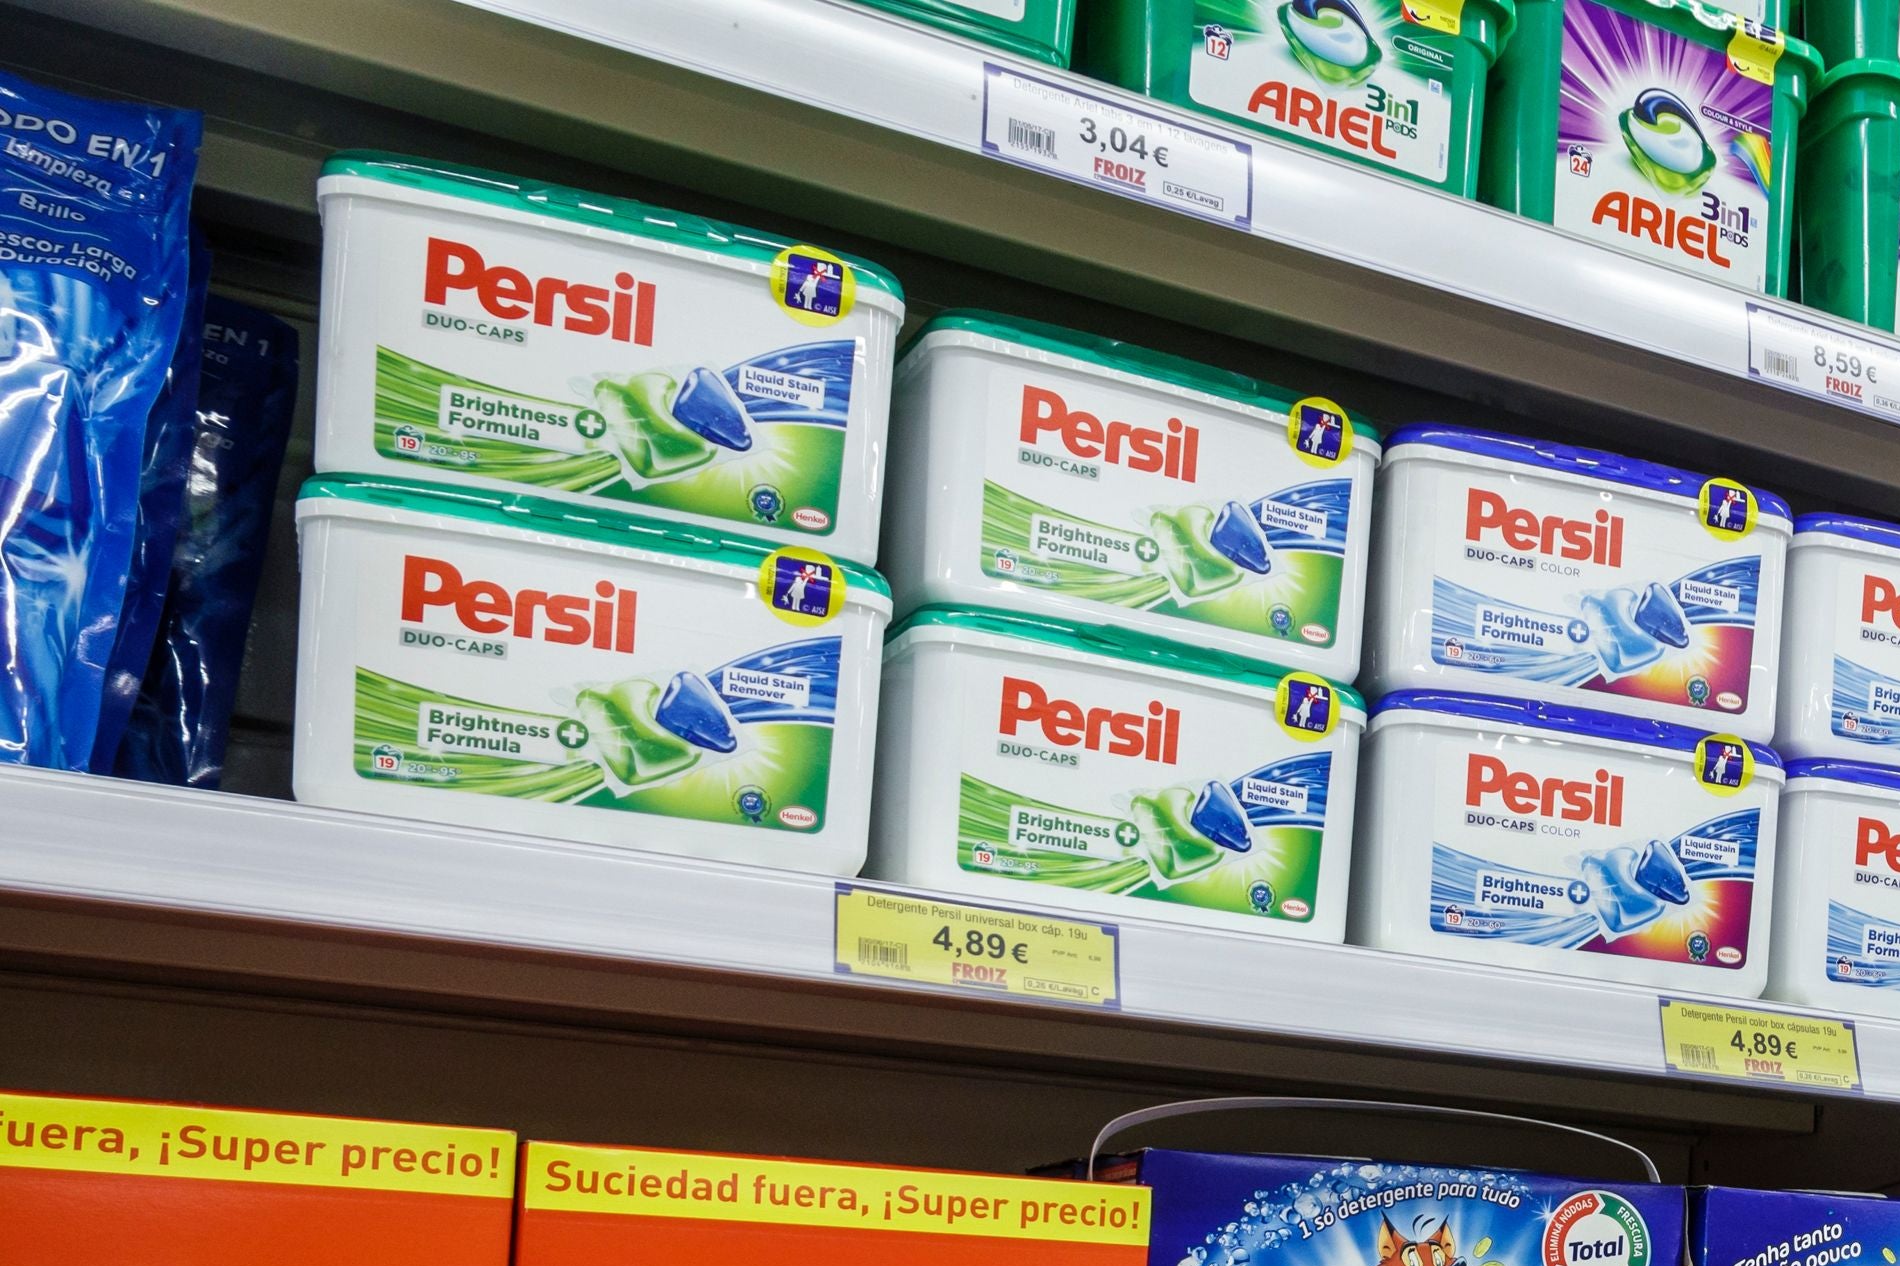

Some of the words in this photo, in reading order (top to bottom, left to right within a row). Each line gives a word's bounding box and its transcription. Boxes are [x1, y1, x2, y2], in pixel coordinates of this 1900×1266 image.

[1209, 37, 1227, 57] 12
[1408, 44, 1444, 63] ORIGINAL
[88, 134, 141, 168] EN
[150, 152, 166, 178] 1
[1573, 157, 1589, 176] 24
[1094, 157, 1146, 186] FROIZ
[19, 192, 86, 222] Brillo
[424, 236, 656, 348] Persil
[744, 368, 784, 390] Liquid
[786, 376, 820, 395] Stain
[744, 382, 801, 401] Remover
[1826, 376, 1862, 398] FROIZ
[400, 436, 417, 450] 19
[1019, 384, 1199, 484] Persil
[1021, 450, 1098, 478] DUO-CAPS
[795, 510, 828, 528] Henkel
[1467, 547, 1534, 569] DUO-CAPS
[1540, 563, 1580, 578] COLOR
[401, 555, 637, 654] Persil
[1482, 625, 1545, 646] Formula
[1483, 610, 1564, 638] Brightness
[404, 631, 505, 658] DUO-CAPS
[427, 728, 522, 755] Formula
[1000, 745, 1078, 767] DUO-CAPS
[1018, 812, 1110, 841] Brightness
[1467, 814, 1535, 833] DUO-CAPS
[1541, 825, 1580, 838] COLOR
[1016, 828, 1088, 852] Formula
[1482, 891, 1545, 909] Formula
[1483, 875, 1564, 899] Brightness
[868, 896, 928, 916] Detergente
[932, 906, 962, 921] Persil
[966, 914, 1014, 929] universal
[1018, 920, 1037, 932] box
[1068, 928, 1088, 940] 19u
[1681, 1008, 1723, 1022] Detergente
[1726, 1015, 1747, 1025] Persil
[1750, 1018, 1768, 1027] color
[1771, 1021, 1784, 1030] box
[1788, 1023, 1820, 1034] cápsulas
[1823, 1027, 1837, 1037] 19u
[545, 1159, 739, 1206] Suciedad
[752, 1181, 870, 1217] fuera,
[883, 1185, 1009, 1225] ¡Super
[1019, 1197, 1140, 1231] precio!
[1299, 1220, 1314, 1240] 1
[1314, 1212, 1336, 1232] só
[1337, 1183, 1434, 1220] detergente
[1437, 1183, 1478, 1202] para
[1481, 1184, 1522, 1210] tudo
[1793, 1221, 1844, 1256] tanto
